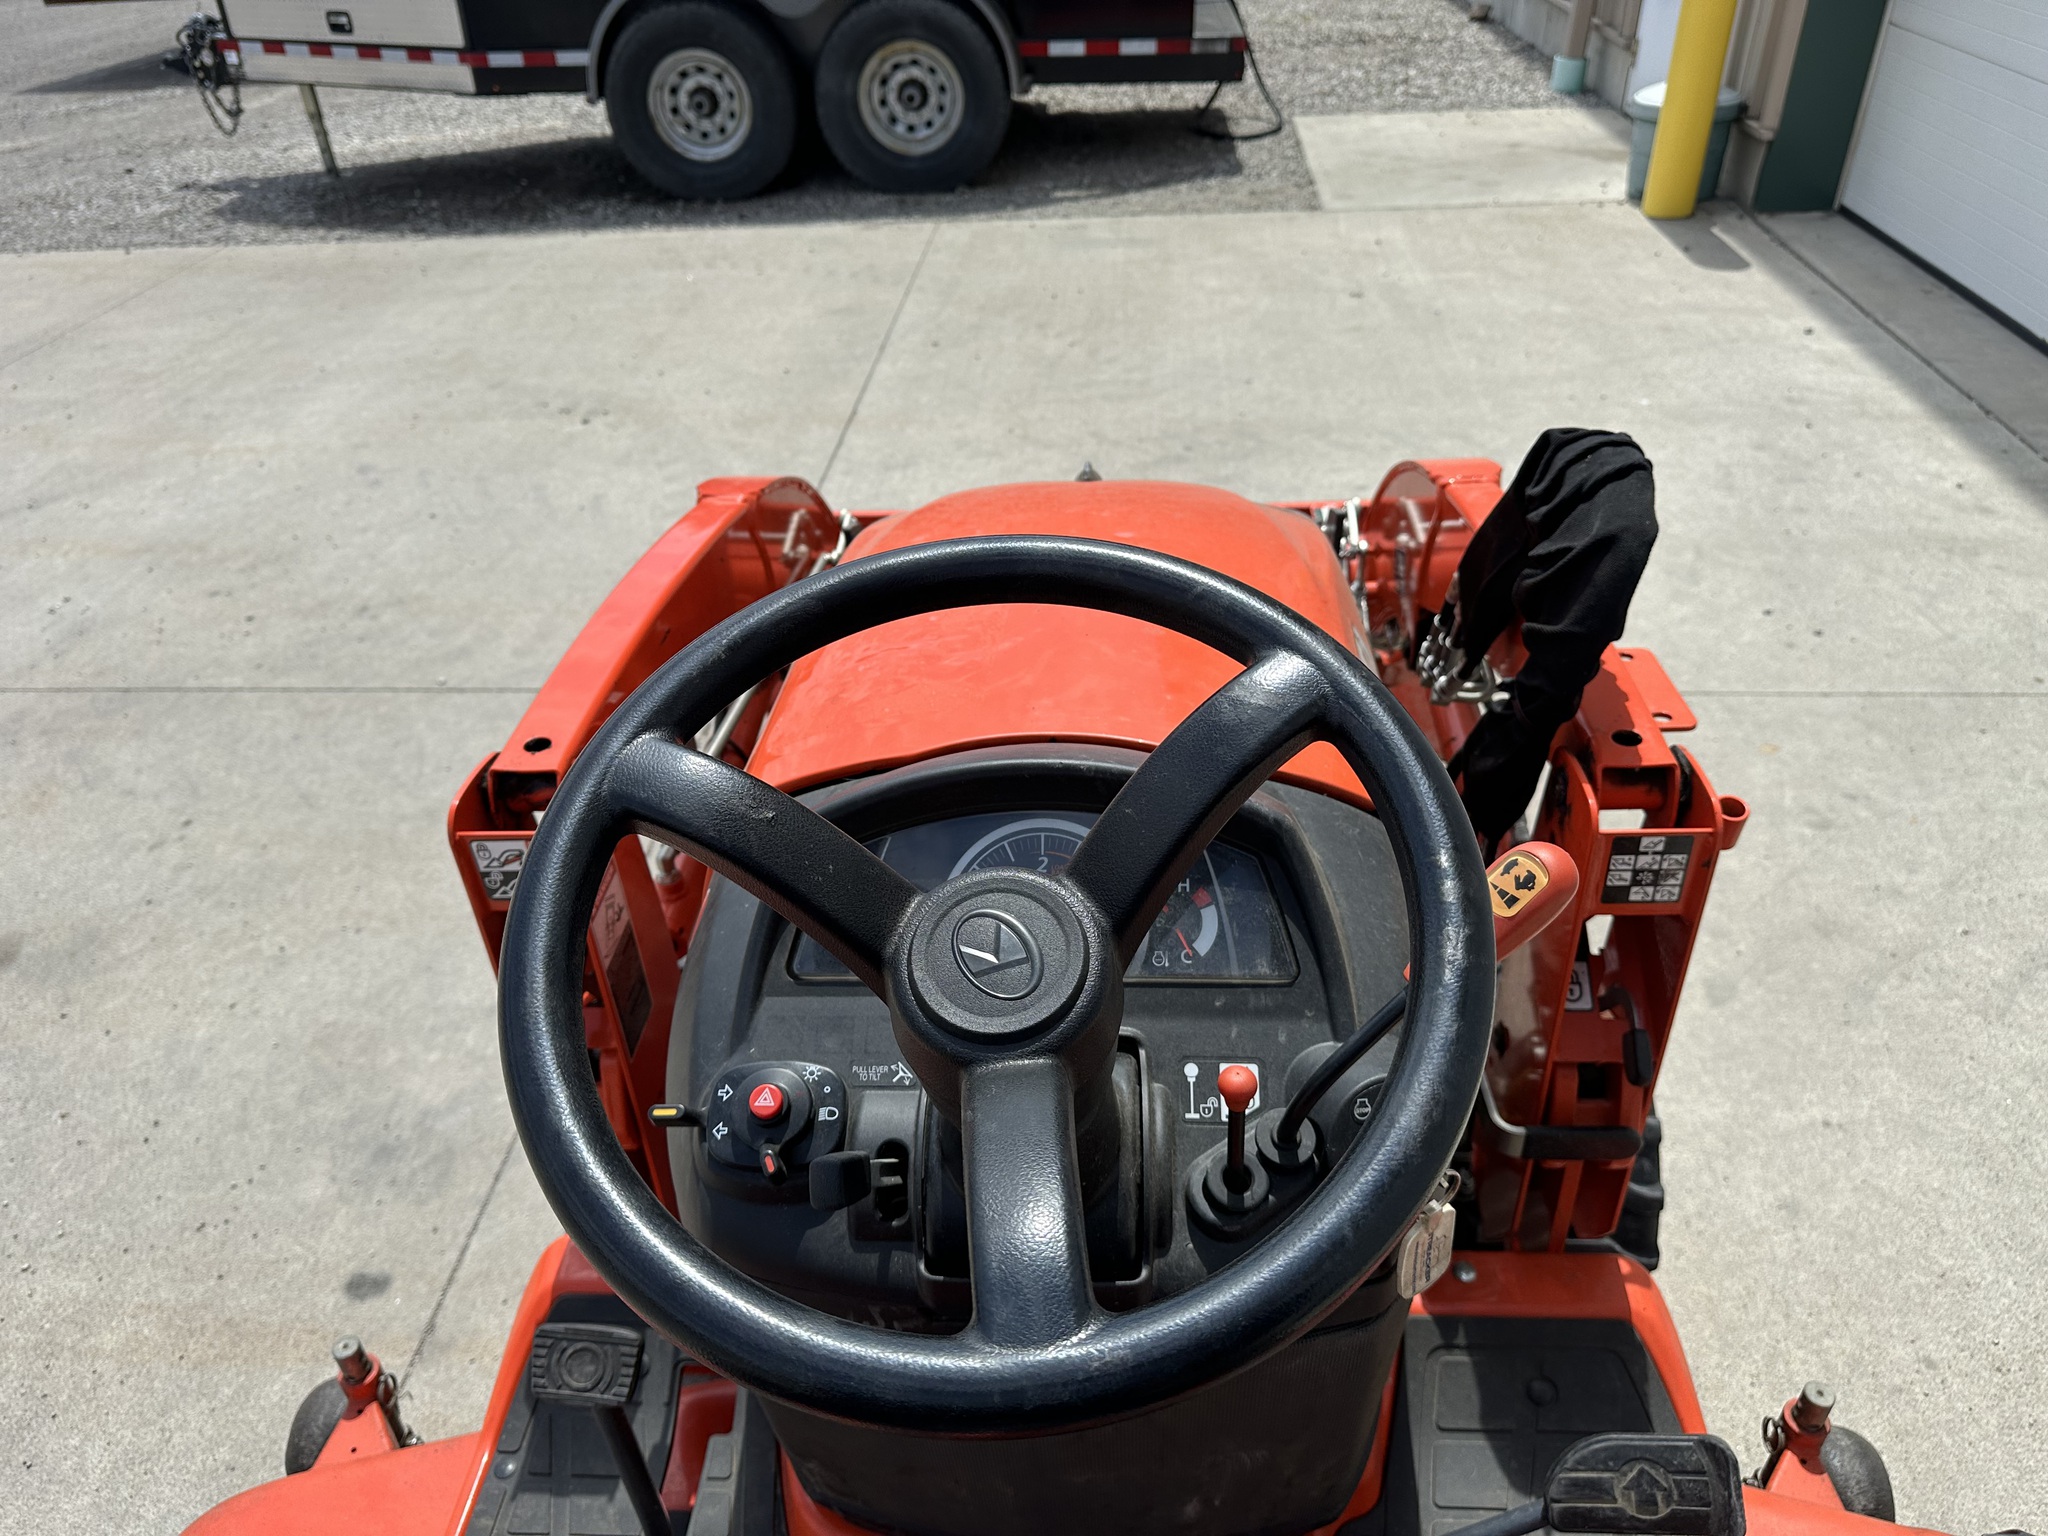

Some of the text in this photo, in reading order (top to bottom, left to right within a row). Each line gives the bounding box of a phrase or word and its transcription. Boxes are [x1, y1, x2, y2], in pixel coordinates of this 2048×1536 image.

[1036, 856, 1049, 873] 2
[1177, 878, 1190, 893] H
[1181, 949, 1193, 964] C
[852, 1065, 889, 1073] PULL LEVER
[859, 1073, 881, 1081] TO TILT
